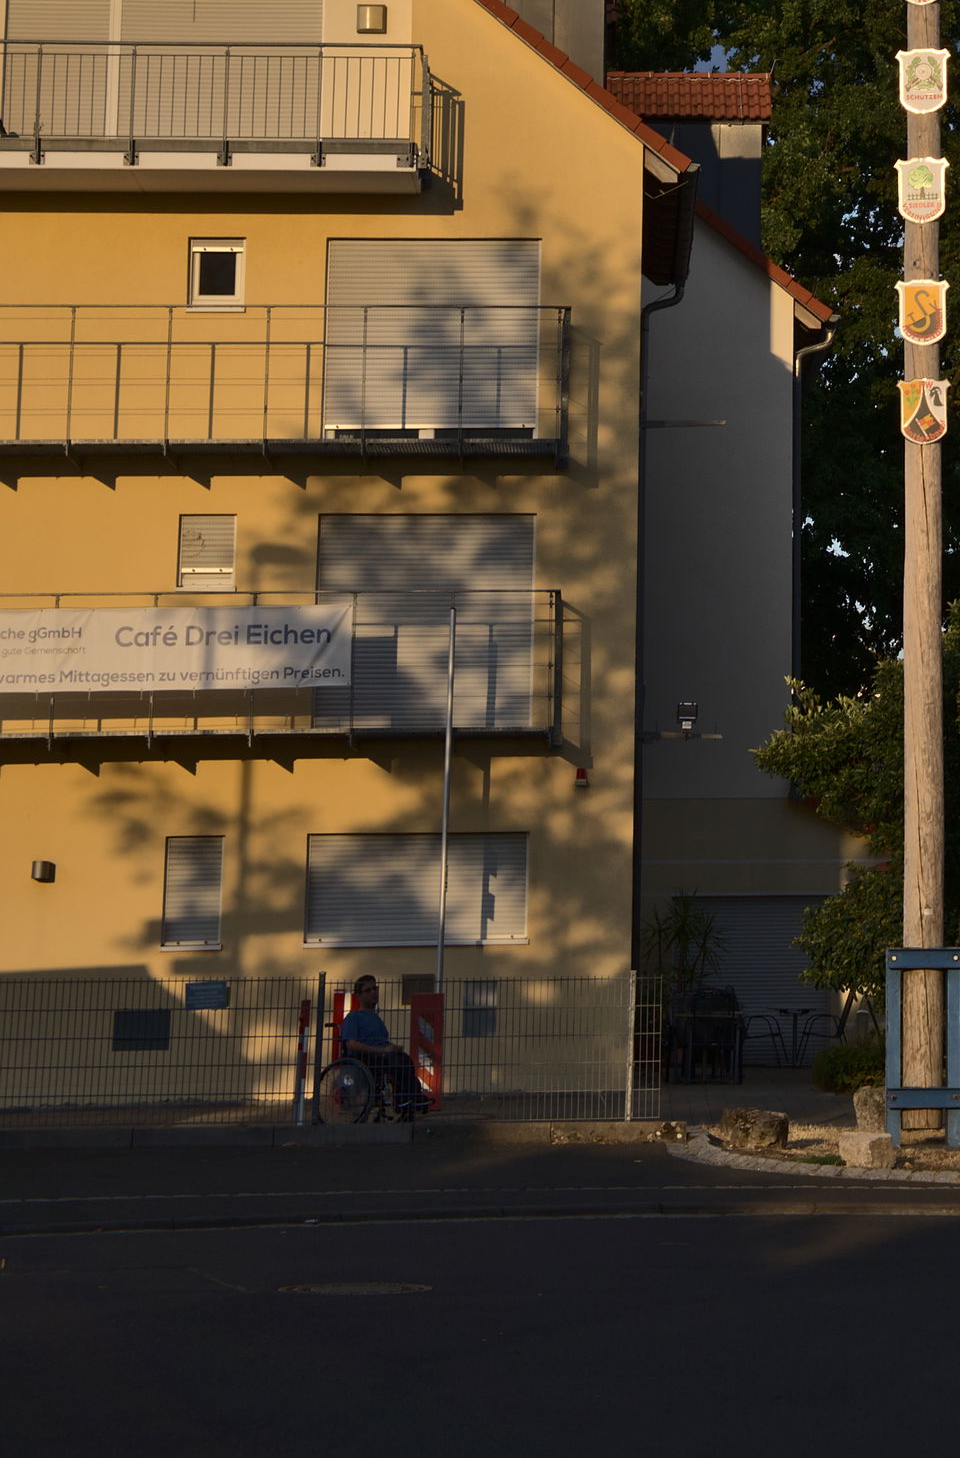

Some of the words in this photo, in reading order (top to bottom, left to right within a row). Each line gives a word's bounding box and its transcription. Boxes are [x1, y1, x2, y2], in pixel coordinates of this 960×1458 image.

[28, 627, 82, 643] gGmbH
[115, 625, 178, 647] Café
[185, 624, 239, 646] Drei
[246, 624, 331, 645] Eichen
[24, 646, 86, 655] Gemeinschaft
[60, 670, 155, 687] Mittagessen
[159, 672, 176, 682] zu
[180, 667, 279, 684] vernünftigen
[283, 666, 345, 679] Preisen.
